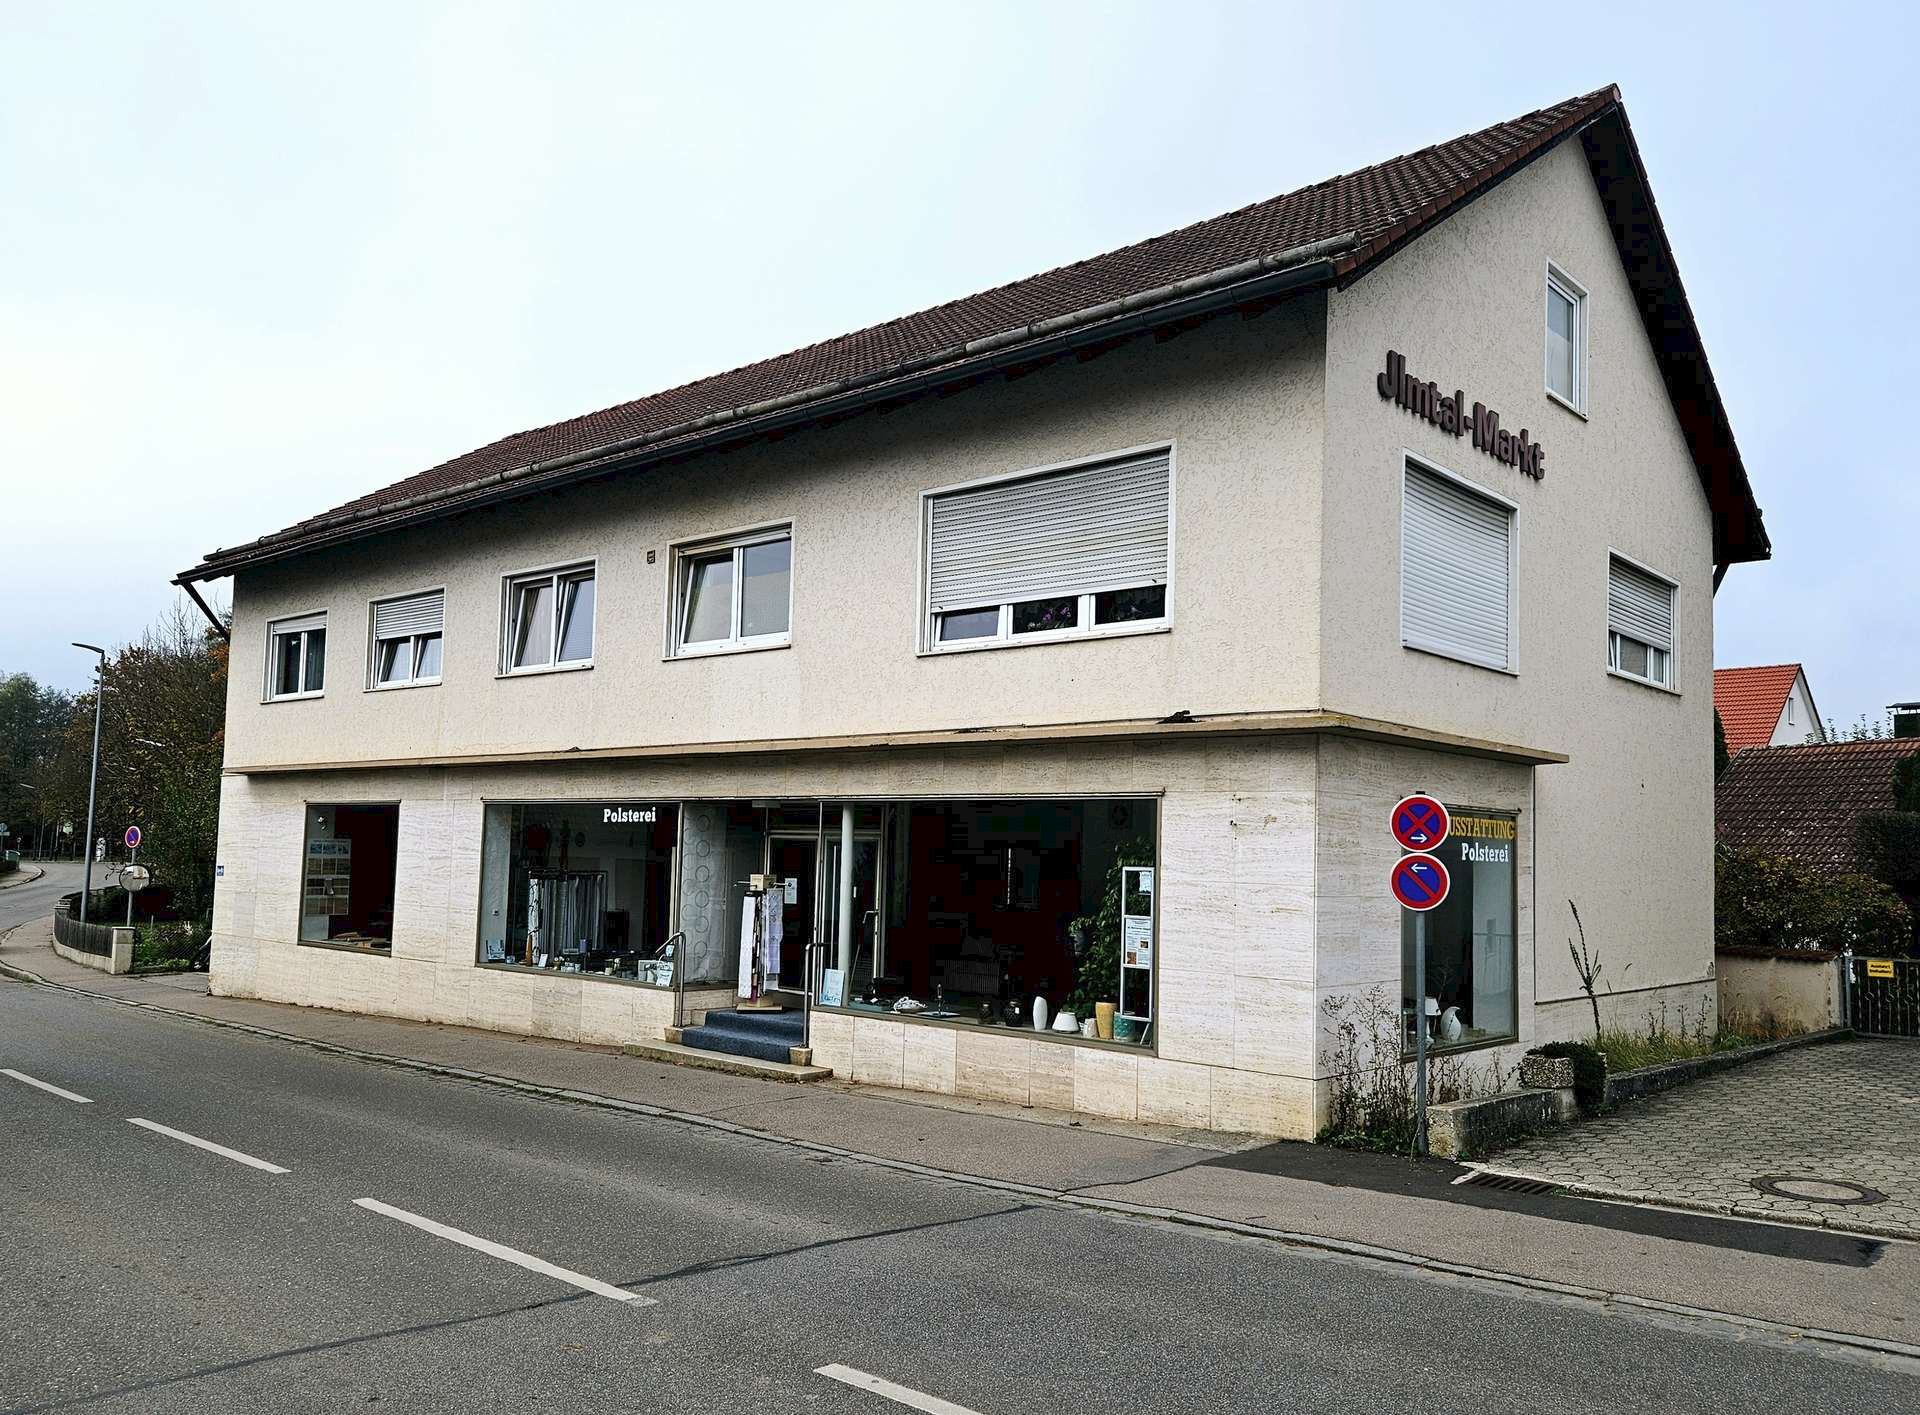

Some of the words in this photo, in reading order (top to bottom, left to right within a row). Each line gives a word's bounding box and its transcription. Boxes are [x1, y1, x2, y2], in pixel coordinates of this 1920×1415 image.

[603, 807, 656, 823] Polsterei
[1448, 816, 1516, 839] USSTATTUNG
[1461, 842, 1509, 862] Polsterei
